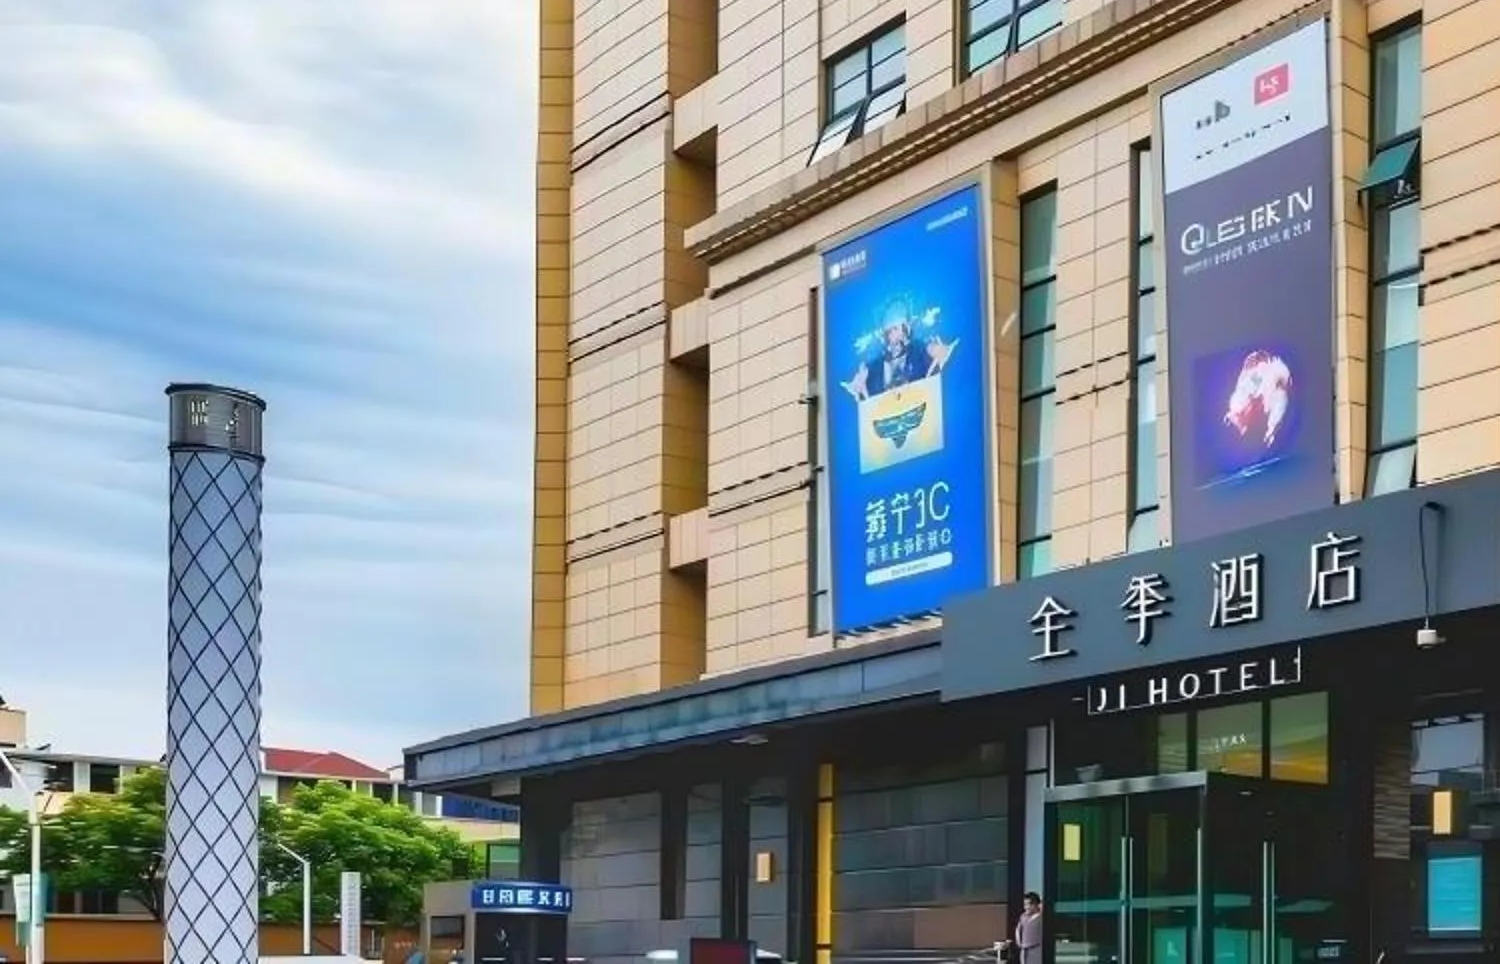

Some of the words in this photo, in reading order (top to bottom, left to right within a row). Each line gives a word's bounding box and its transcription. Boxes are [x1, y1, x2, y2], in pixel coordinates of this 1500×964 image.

[1027, 531, 1362, 662] 全季酒店
[1097, 684, 1125, 712] JI
[1149, 657, 1285, 704] HOTEL
